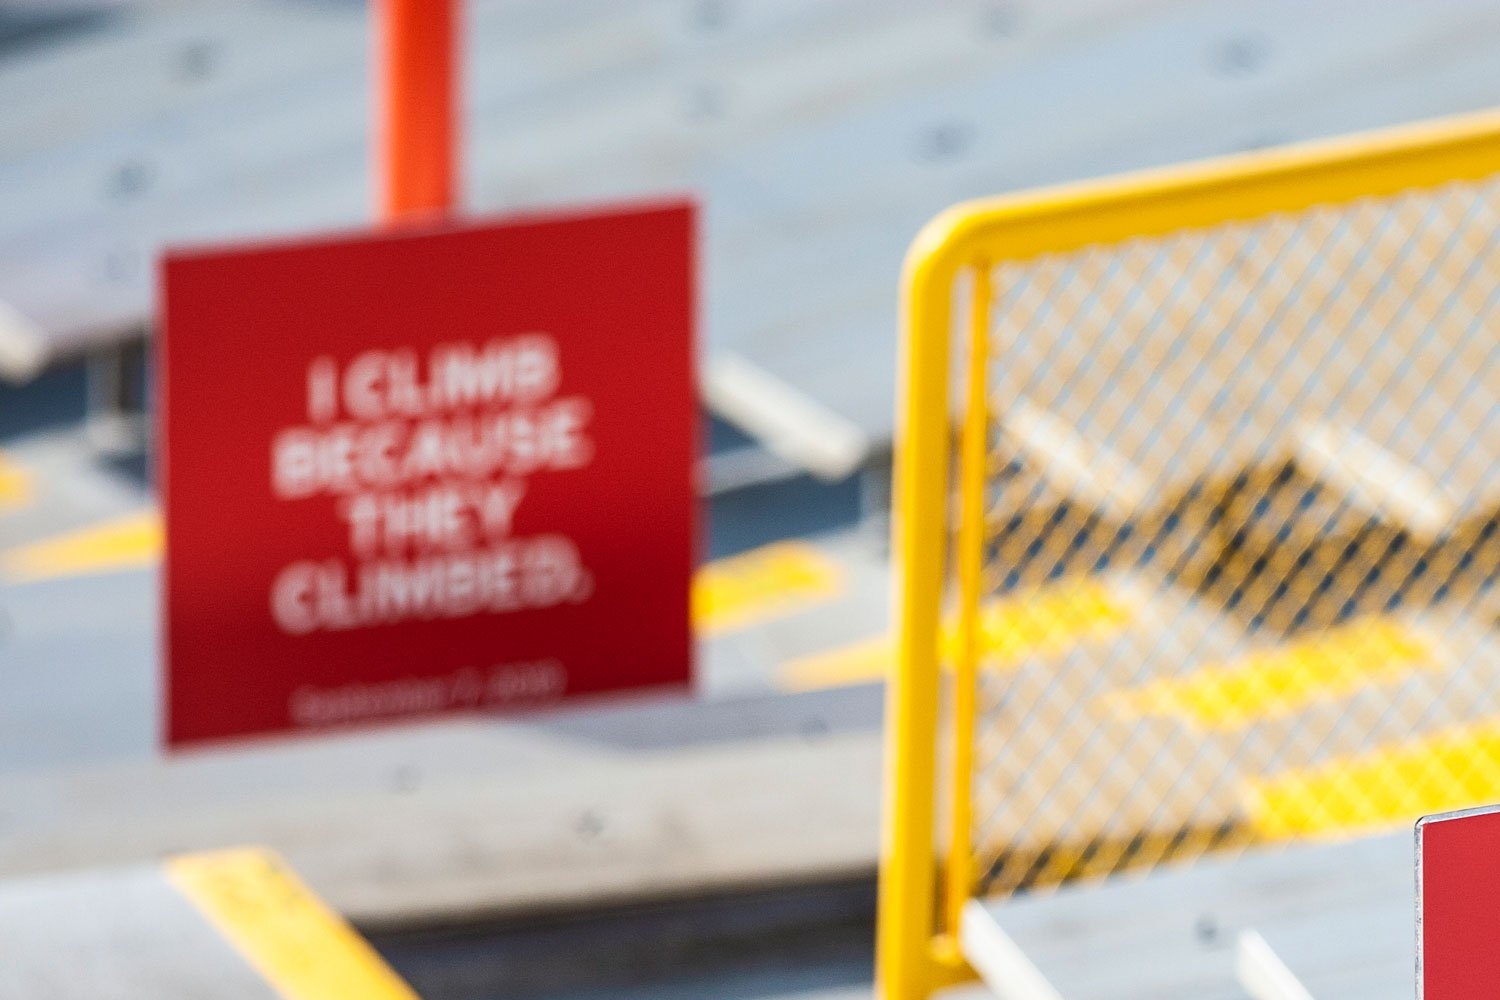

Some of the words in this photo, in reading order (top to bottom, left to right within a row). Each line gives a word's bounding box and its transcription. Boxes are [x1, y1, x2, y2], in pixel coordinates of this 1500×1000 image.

[307, 352, 339, 423] I
[343, 332, 562, 422] CLIMB
[271, 397, 596, 500] BECAUSE
[335, 475, 528, 560] THEY
[269, 532, 596, 635] CLIMBED.
